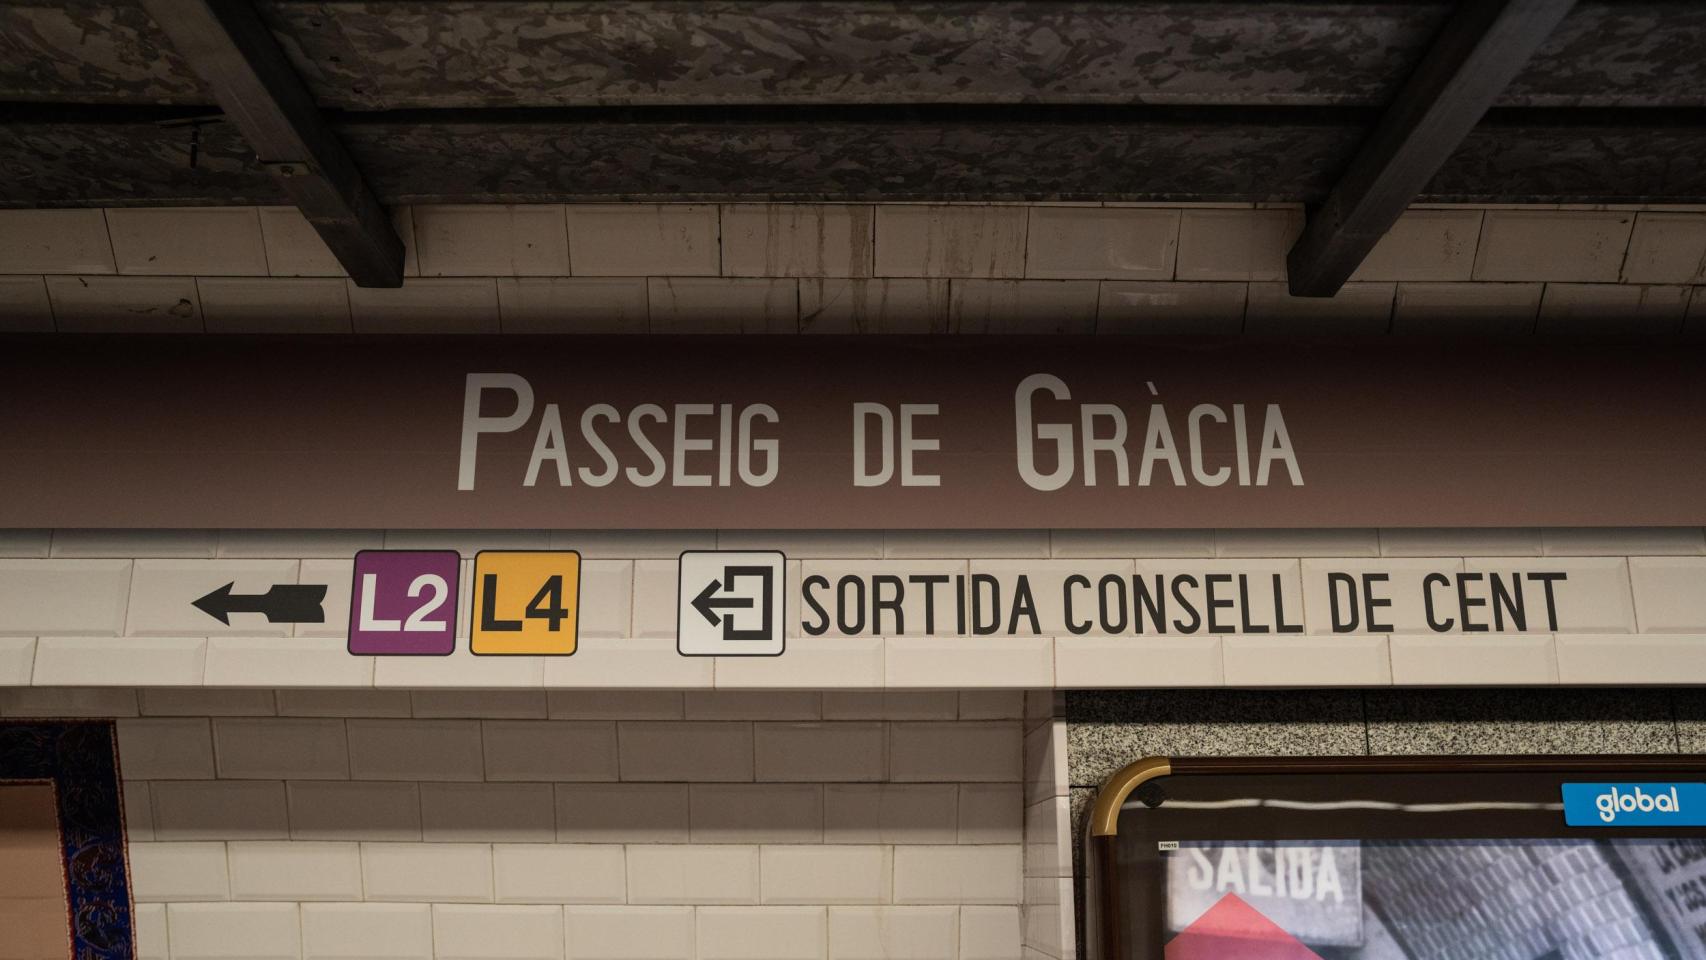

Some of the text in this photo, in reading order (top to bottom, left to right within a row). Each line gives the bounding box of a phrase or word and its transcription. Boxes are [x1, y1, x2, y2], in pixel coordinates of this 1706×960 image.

[358, 573, 449, 632] L2
[480, 573, 569, 632] L4
[801, 572, 1567, 636] SORTIDA CONSELL DE CENT
[1596, 786, 1680, 822] global
[1187, 842, 1344, 903] SALIDA
